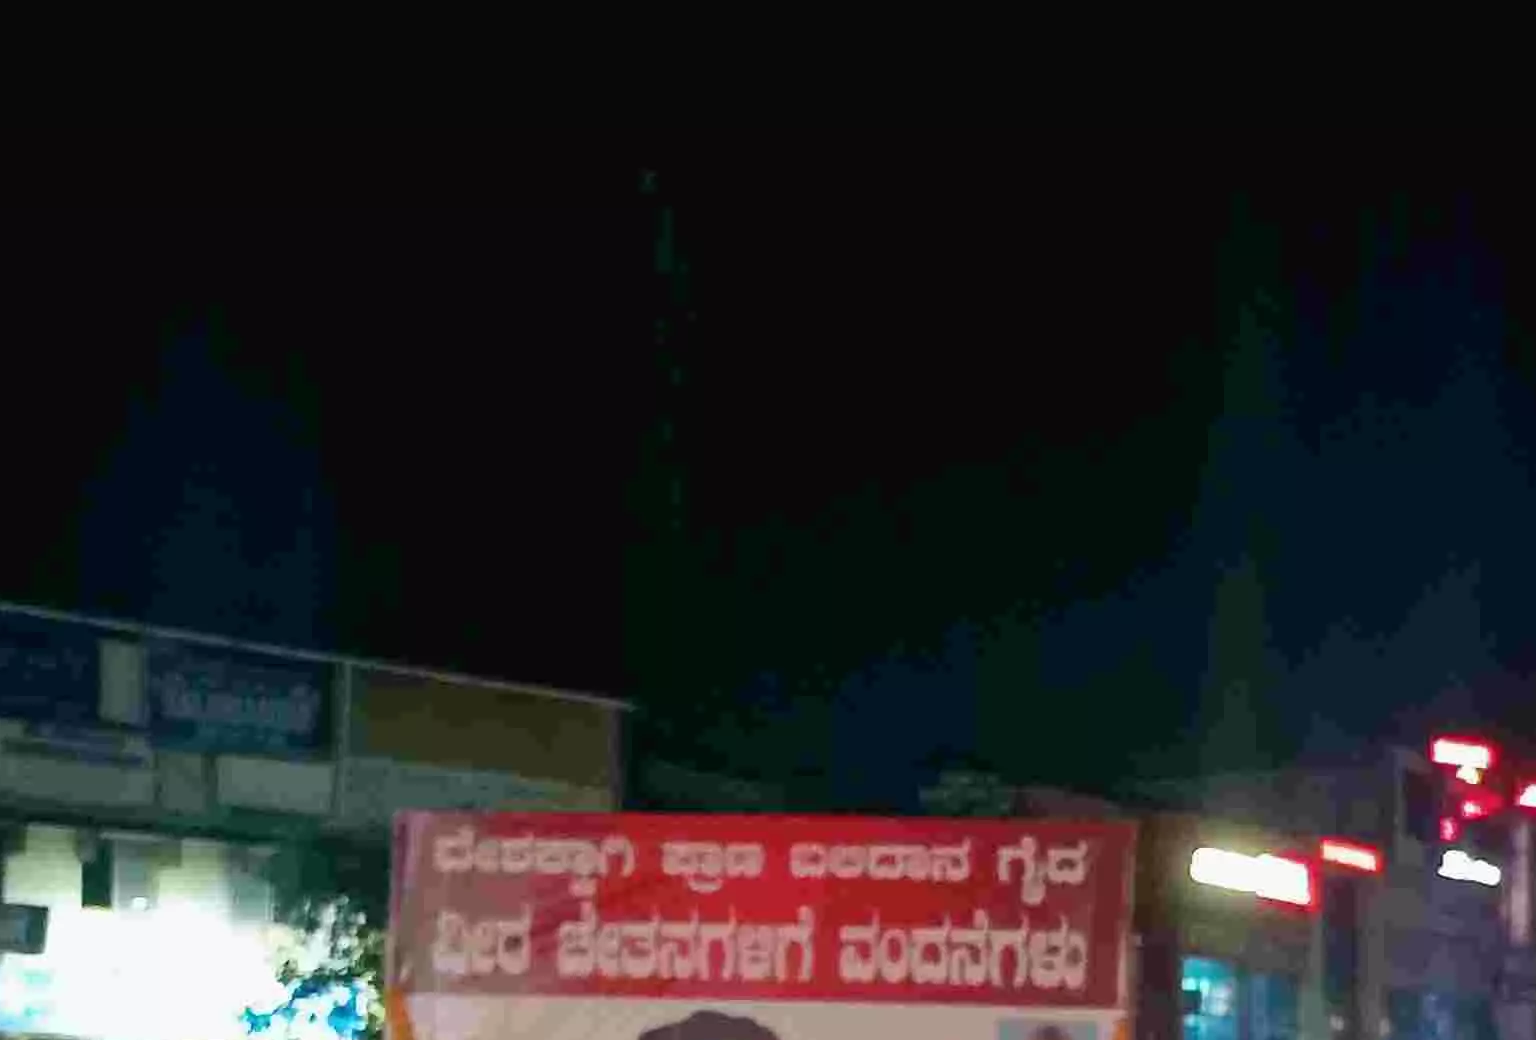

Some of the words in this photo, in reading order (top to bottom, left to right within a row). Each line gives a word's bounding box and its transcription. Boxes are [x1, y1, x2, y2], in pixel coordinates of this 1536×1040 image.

[660, 841, 765, 893] ಪ್ರಾಣ
[432, 904, 532, 976] ವೀರ
[839, 908, 1088, 988] ವಂದನೆಗಳು
